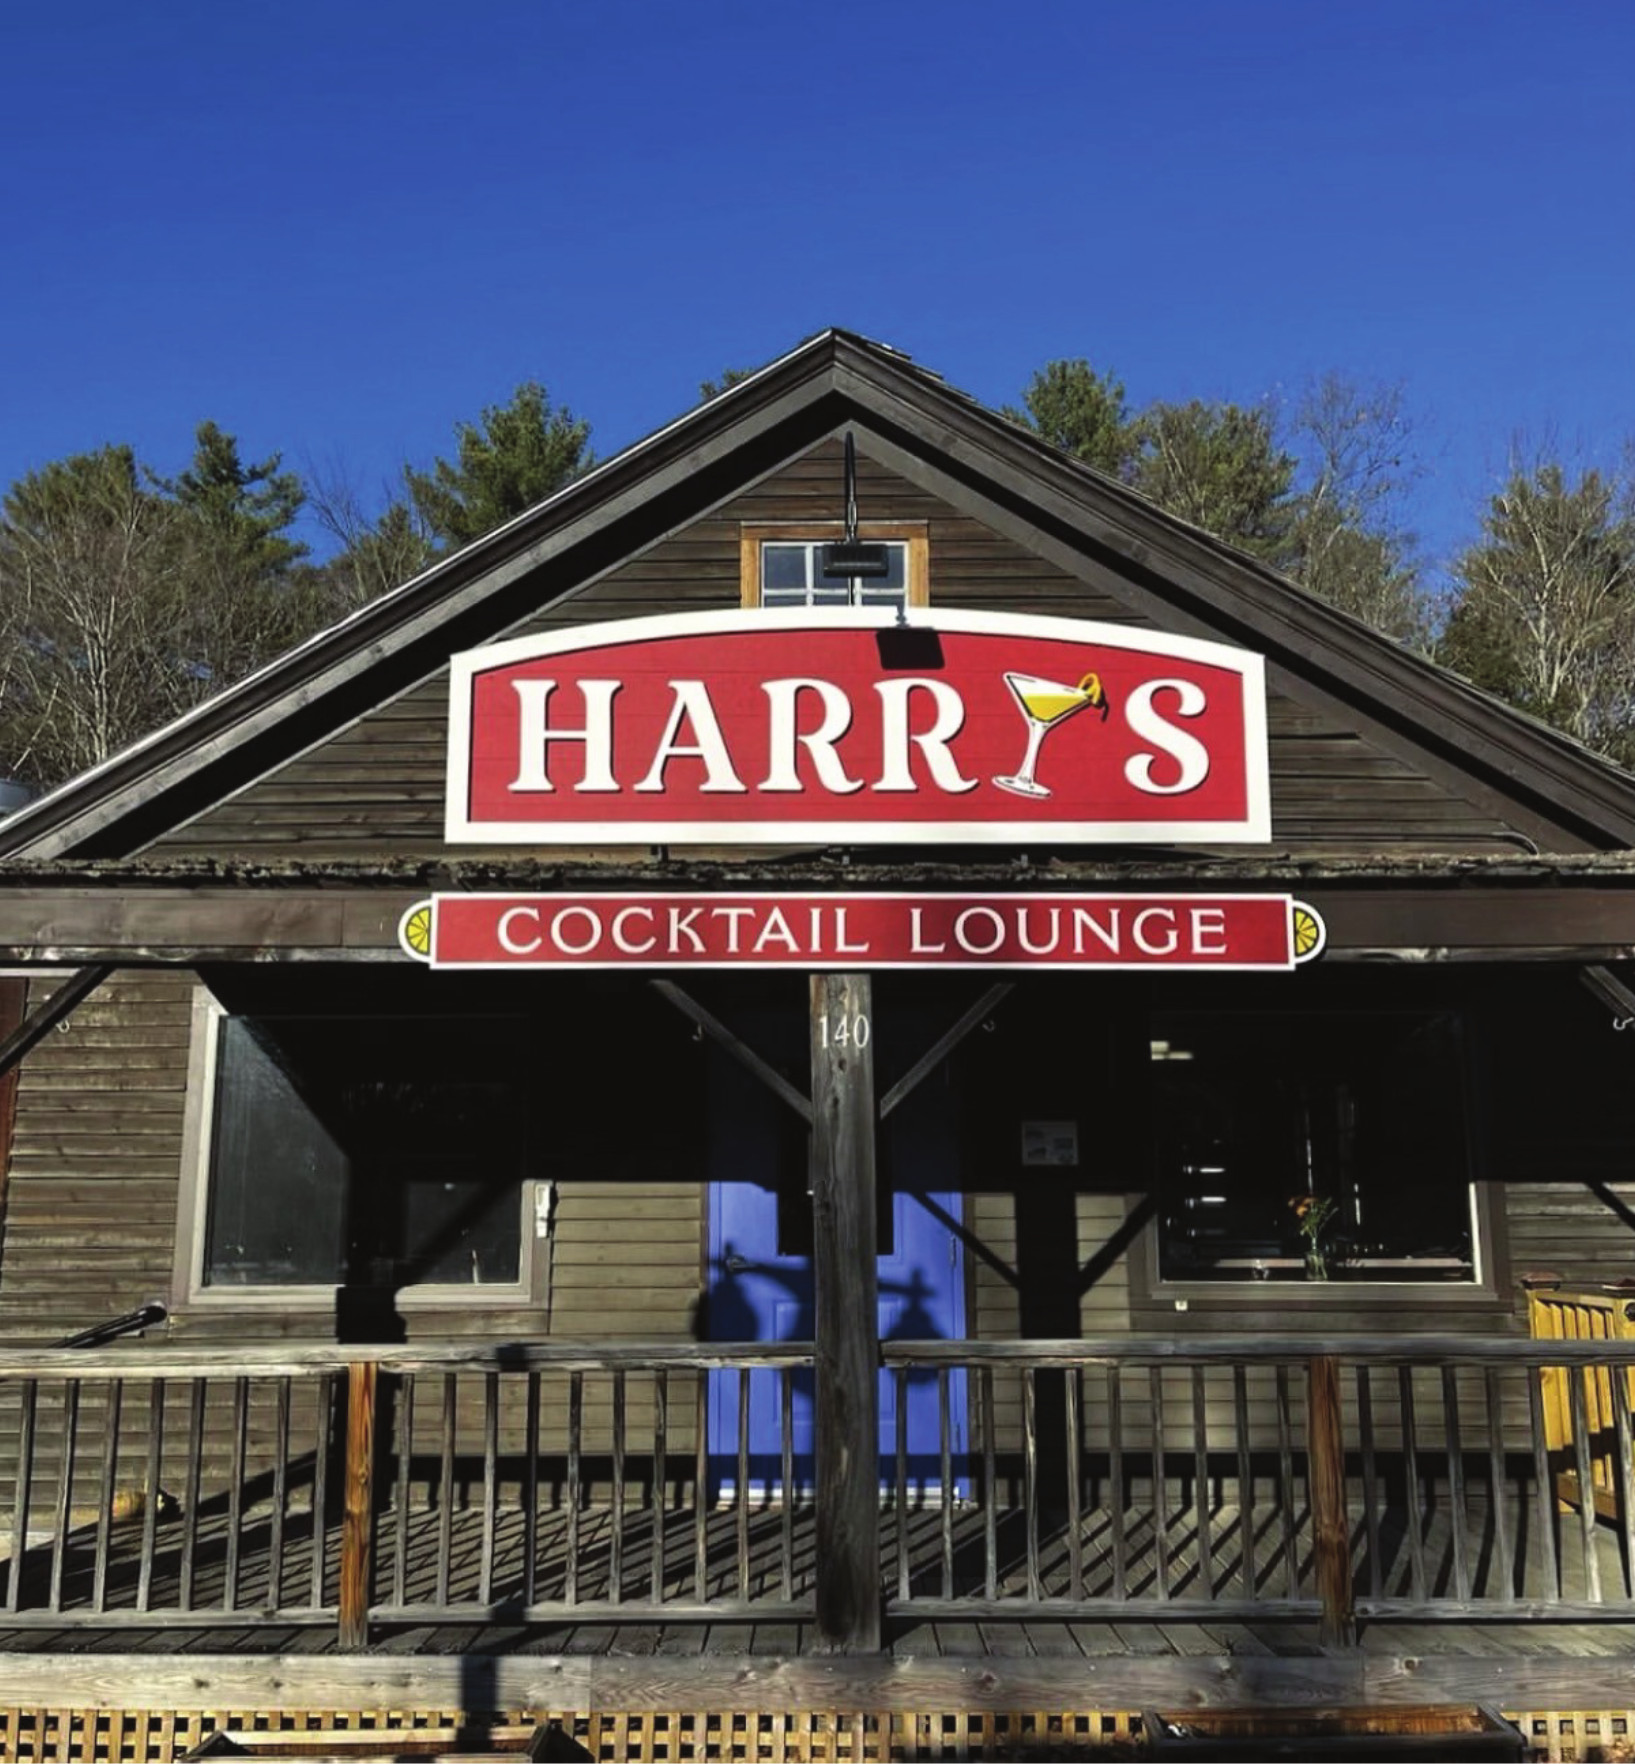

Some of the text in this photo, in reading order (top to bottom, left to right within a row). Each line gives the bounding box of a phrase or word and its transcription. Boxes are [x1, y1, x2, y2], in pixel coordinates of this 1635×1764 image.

[497, 907, 1228, 956] COCKTAIL LOUNGE
[819, 1014, 869, 1048] 140
